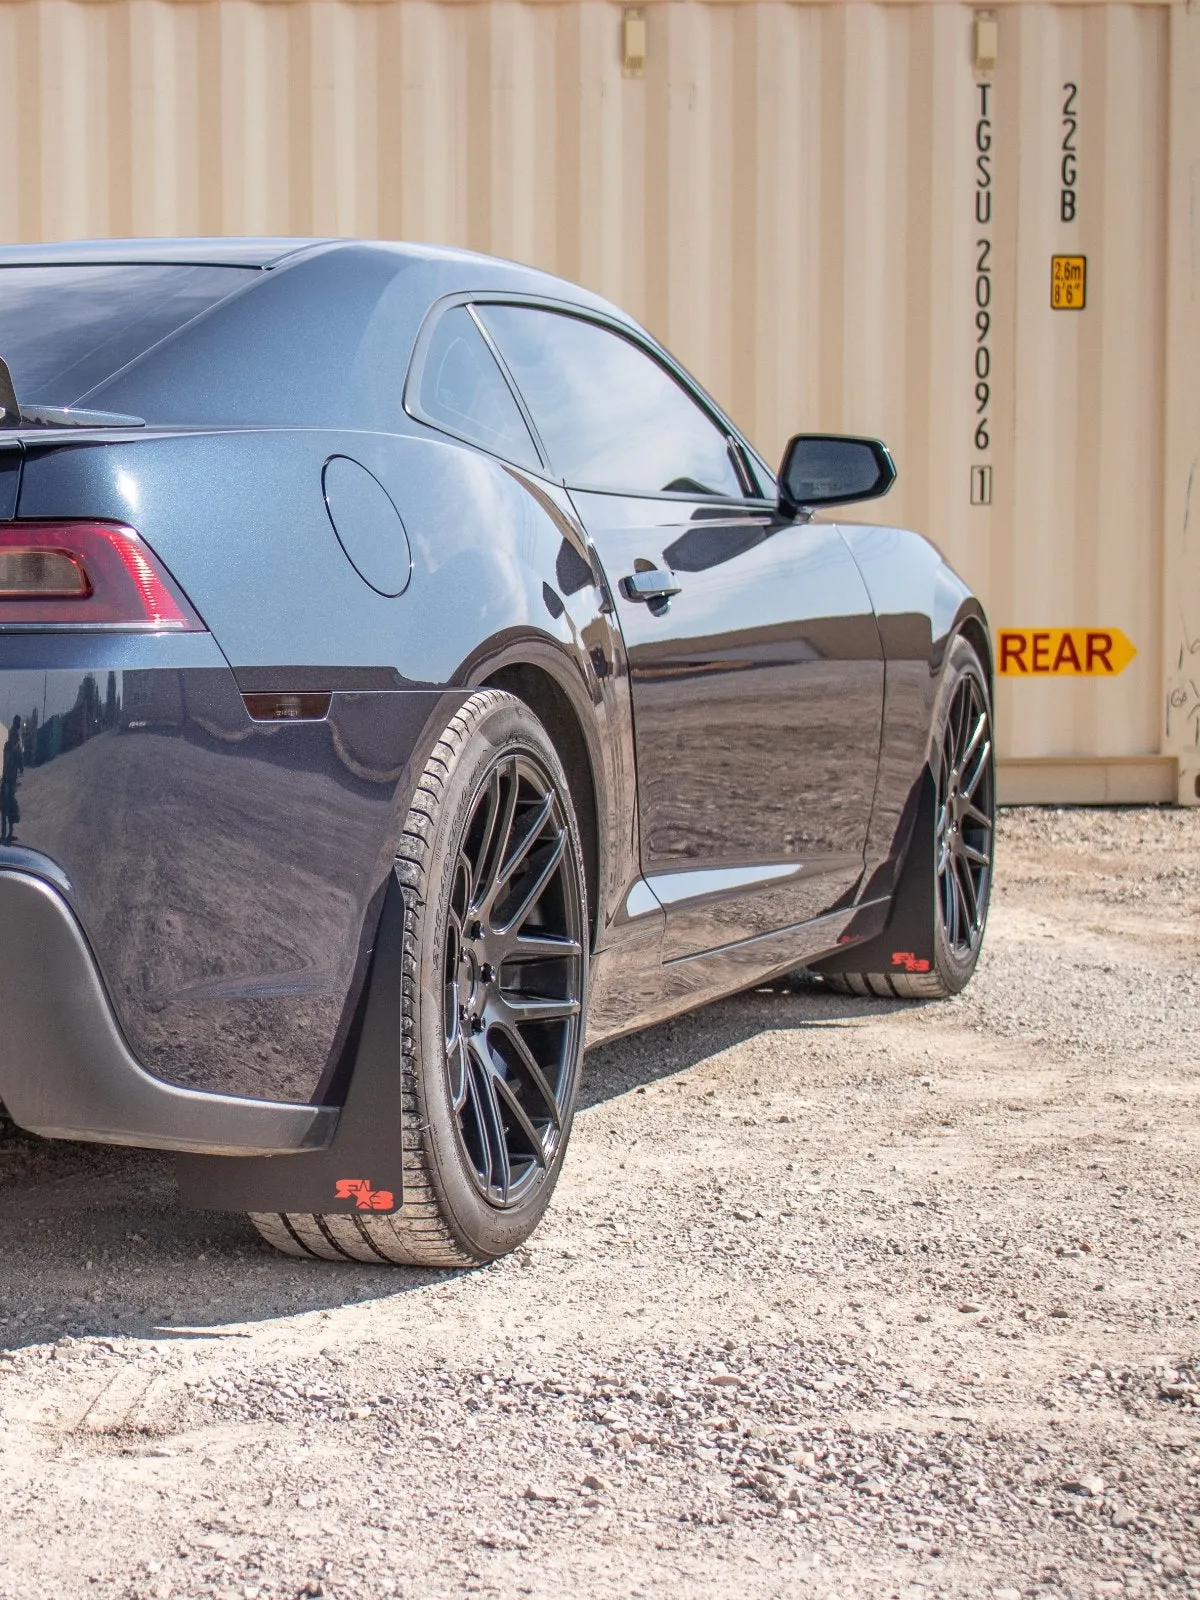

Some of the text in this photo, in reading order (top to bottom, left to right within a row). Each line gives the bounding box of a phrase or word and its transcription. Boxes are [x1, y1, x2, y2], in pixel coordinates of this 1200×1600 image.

[975, 83, 992, 224] TGSU
[1060, 82, 1078, 223] 22GB
[974, 239, 991, 451] 209096
[1000, 633, 1114, 672] REAR
